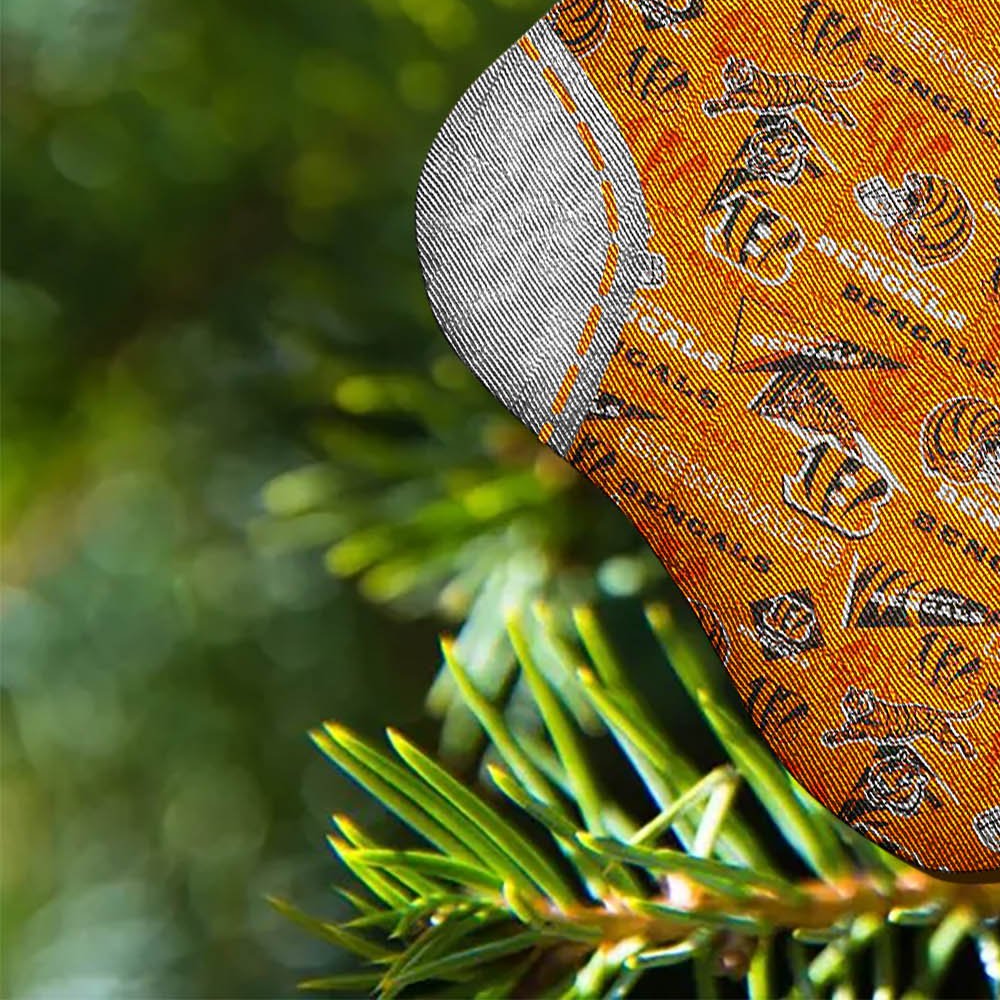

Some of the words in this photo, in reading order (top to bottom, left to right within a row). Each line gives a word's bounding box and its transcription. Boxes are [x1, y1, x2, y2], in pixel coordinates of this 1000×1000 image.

[813, 233, 968, 331] BENGALS
[839, 281, 999, 382] BENGALS
[617, 478, 775, 577] BENGALS
